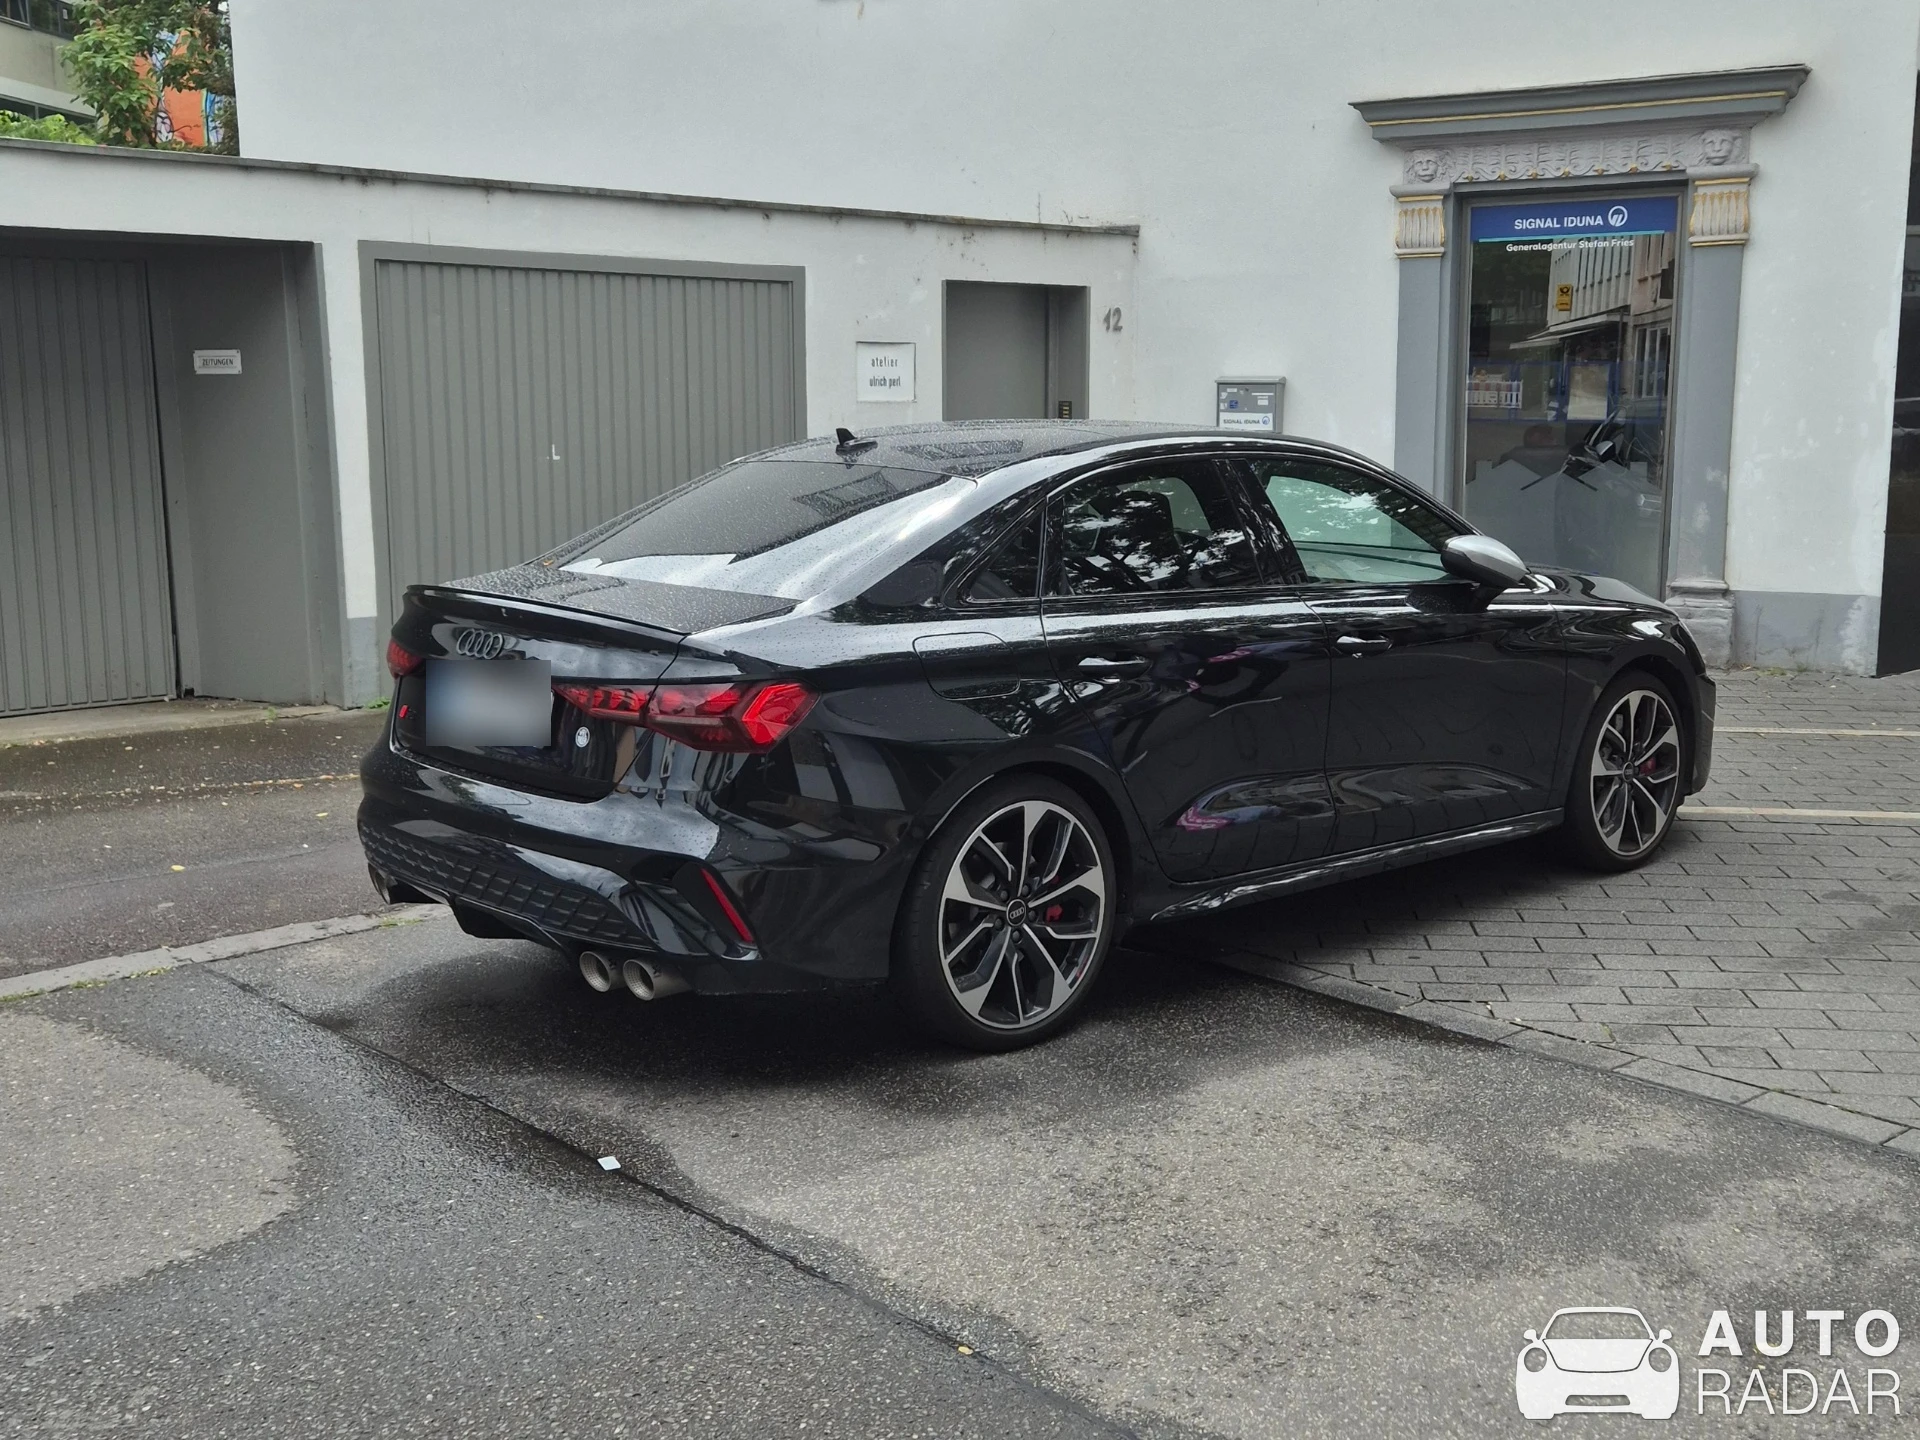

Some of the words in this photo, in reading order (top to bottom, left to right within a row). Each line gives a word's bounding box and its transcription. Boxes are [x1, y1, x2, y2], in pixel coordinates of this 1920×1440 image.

[1514, 217, 1561, 230] SIGNAL
[1563, 214, 1604, 227] IDUNA
[1506, 241, 1577, 252] Generalagentur
[1578, 239, 1609, 249] Stefan
[1611, 237, 1635, 247] Fries
[1103, 307, 1123, 332] 12
[202, 358, 234, 367] ZEITUNGEN
[871, 356, 898, 368] atelier
[869, 375, 888, 387] ulrich
